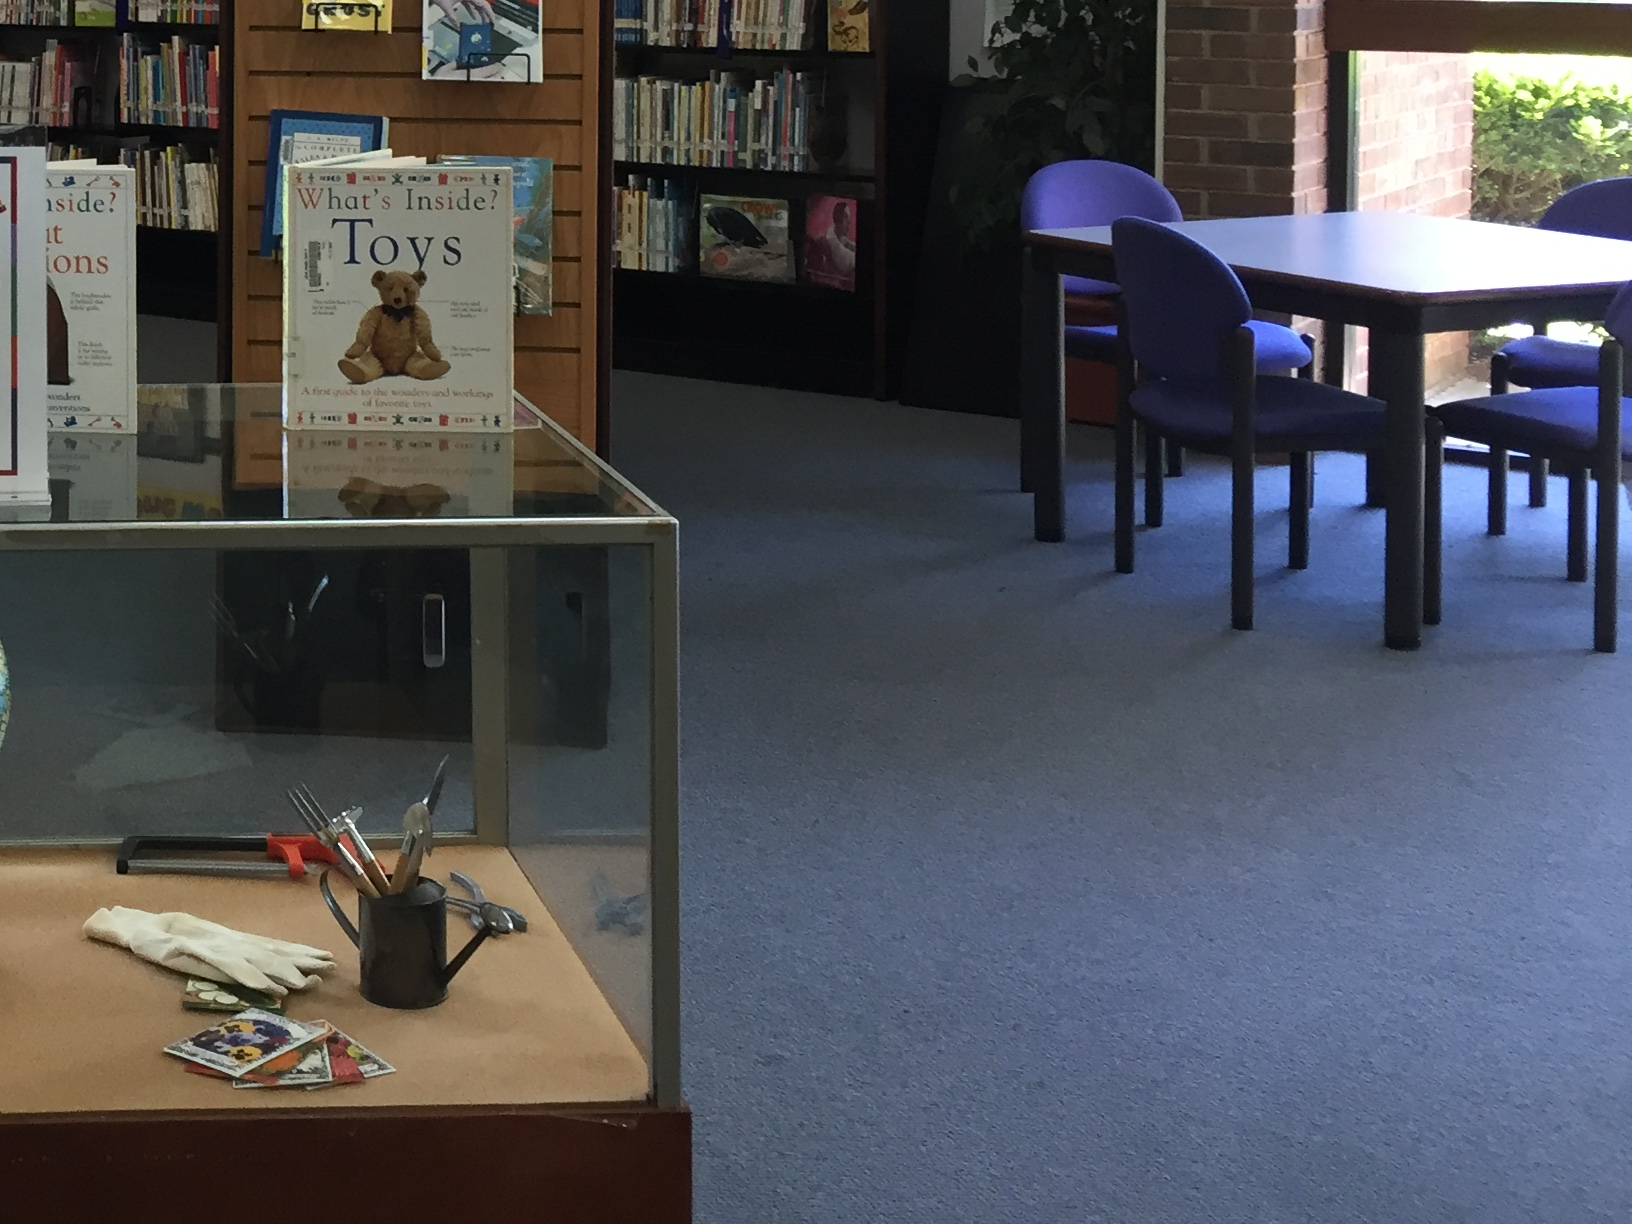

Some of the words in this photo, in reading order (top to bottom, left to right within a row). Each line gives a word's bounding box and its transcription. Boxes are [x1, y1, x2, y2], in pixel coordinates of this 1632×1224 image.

[296, 187, 391, 210] What's
[406, 188, 499, 210] Inside?
[331, 218, 463, 269] Toys
